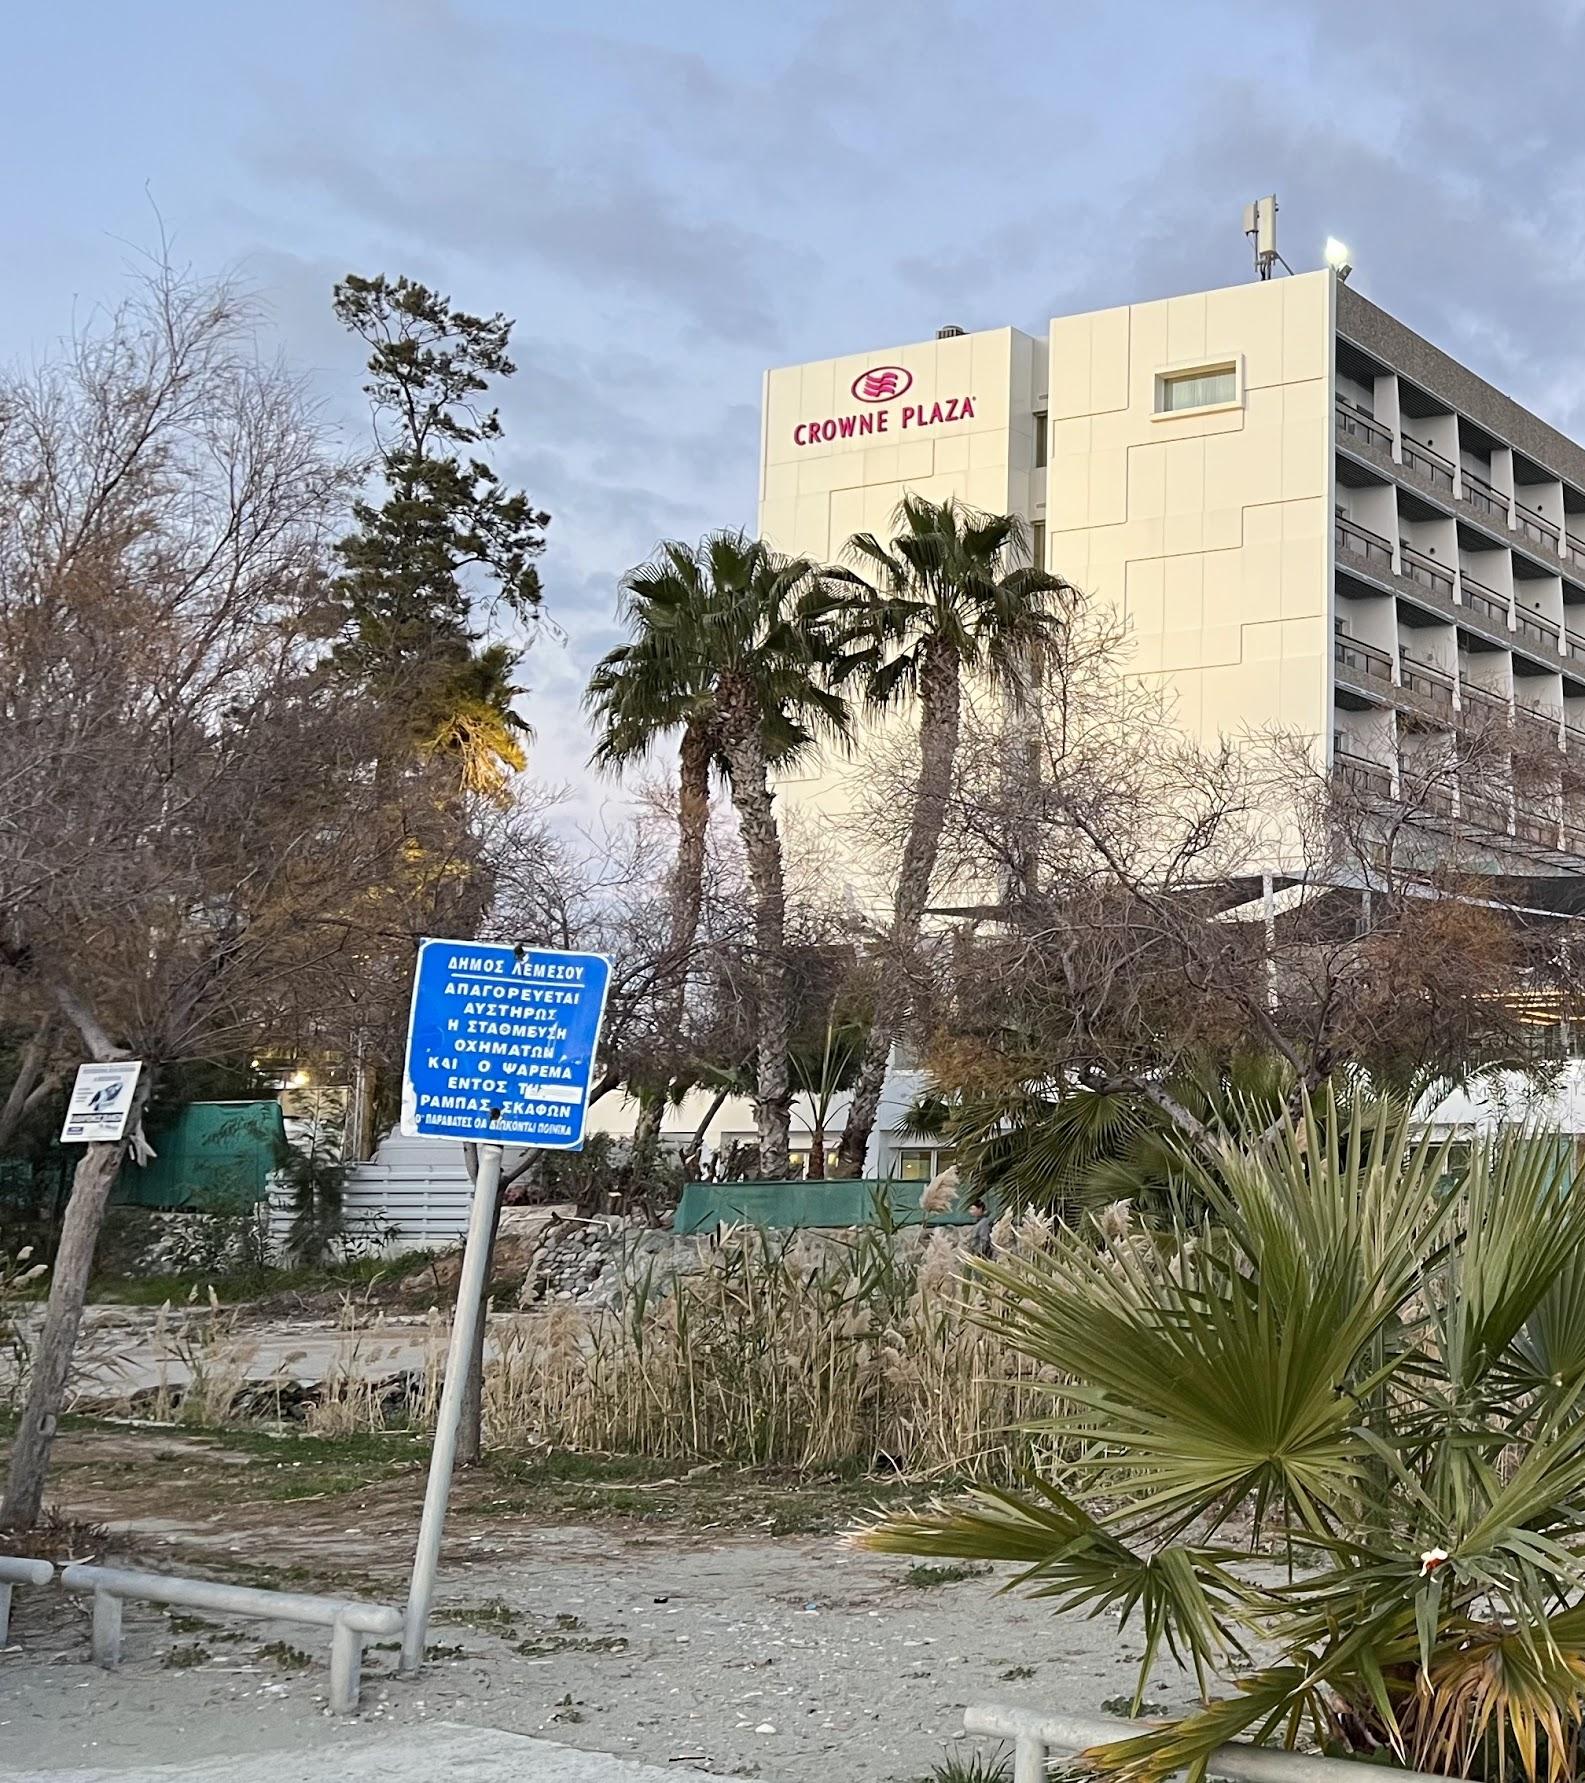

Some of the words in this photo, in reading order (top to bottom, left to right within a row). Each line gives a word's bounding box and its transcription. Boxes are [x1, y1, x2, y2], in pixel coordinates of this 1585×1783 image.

[794, 410, 889, 446] CROWNE
[902, 396, 975, 429] PLAZA
[448, 957, 504, 973] ΔΗΜΟΣ
[511, 962, 584, 980] ΛΕΜΕΣΟΥ
[444, 982, 580, 1004] ΑΠΑΓΟΡΕΥΕΤΑΙ
[463, 1003, 557, 1021] ΑΥΣΤΗΡΩΣ
[447, 1019, 459, 1031] Η
[467, 1020, 567, 1040] ΣΤΑΘΜΕΥΣΗ
[454, 1039, 555, 1059] ΟΧΗΜΑΤΩΝ
[428, 1057, 458, 1070] ΚΑΙ
[478, 1060, 491, 1073] Ο
[502, 1062, 572, 1079] ΨΑΡΕΜΑ
[448, 1077, 507, 1094] ΕΝΤΟΣ
[420, 1095, 491, 1112] ΡΑΜΠΑΣ
[502, 1101, 571, 1118] ΣΚΑΦΩΝ
